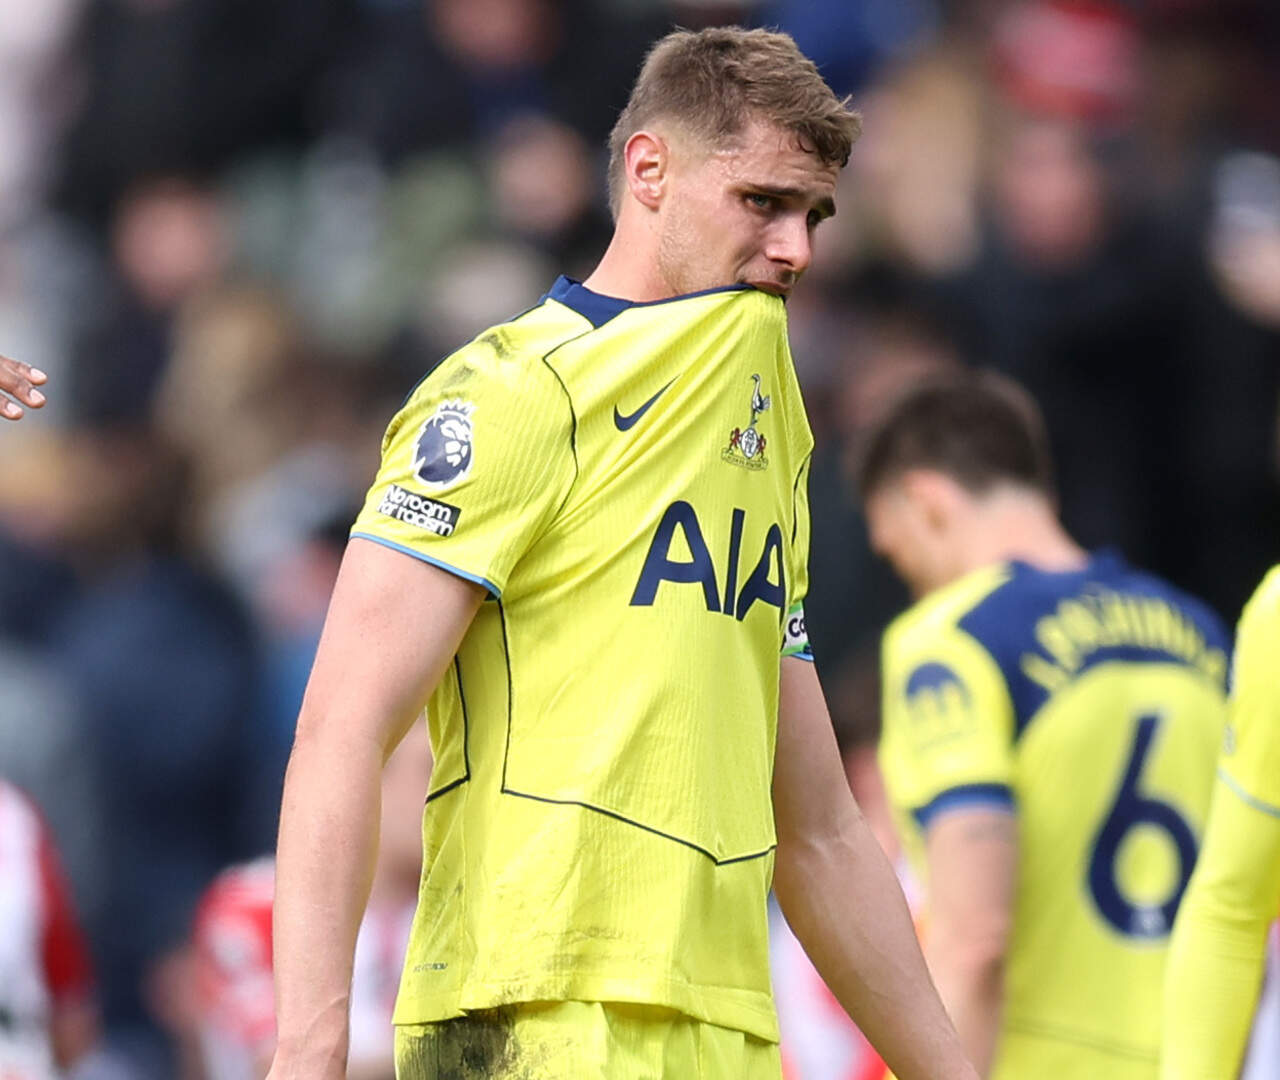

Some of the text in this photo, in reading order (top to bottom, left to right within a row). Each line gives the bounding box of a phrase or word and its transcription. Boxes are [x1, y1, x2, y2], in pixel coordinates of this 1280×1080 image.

[403, 494, 451, 522] room
[629, 500, 786, 622] AIA
[1084, 713, 1202, 940] 6
